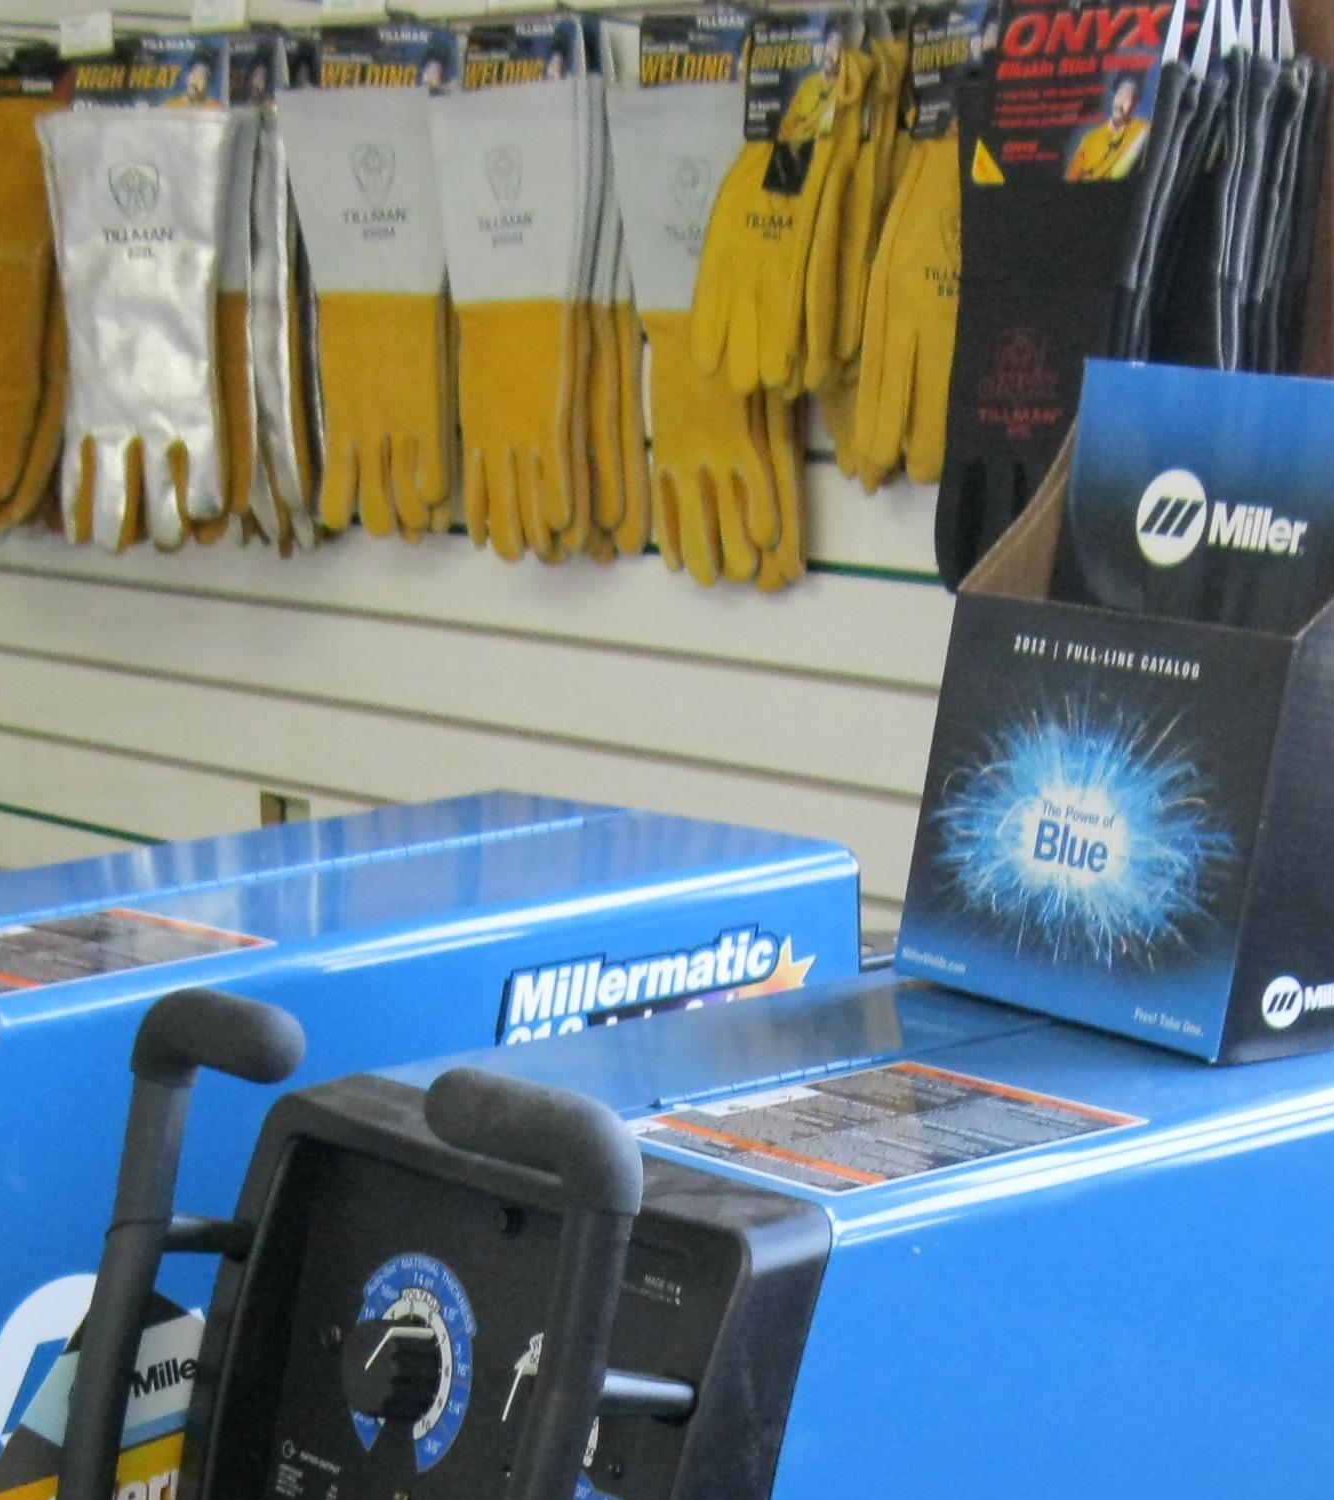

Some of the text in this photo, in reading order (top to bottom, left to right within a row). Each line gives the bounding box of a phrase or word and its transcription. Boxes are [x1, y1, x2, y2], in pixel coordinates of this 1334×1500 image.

[1000, 4, 1174, 58] ONYX
[75, 64, 125, 91] HIGH
[129, 63, 182, 90] HEAT
[319, 62, 418, 90] WELDING
[463, 57, 546, 91] WELDING
[641, 52, 735, 85] WELDING
[343, 207, 407, 225] TILLMAN
[102, 227, 176, 244] TILLMAN
[1208, 501, 1309, 555] Miller
[1014, 633, 1201, 681] 2012 FULL-LINE CATALOG
[1043, 800, 1116, 829] The Power of
[1033, 818, 1109, 873] Blue
[509, 931, 774, 1025] Millermatic
